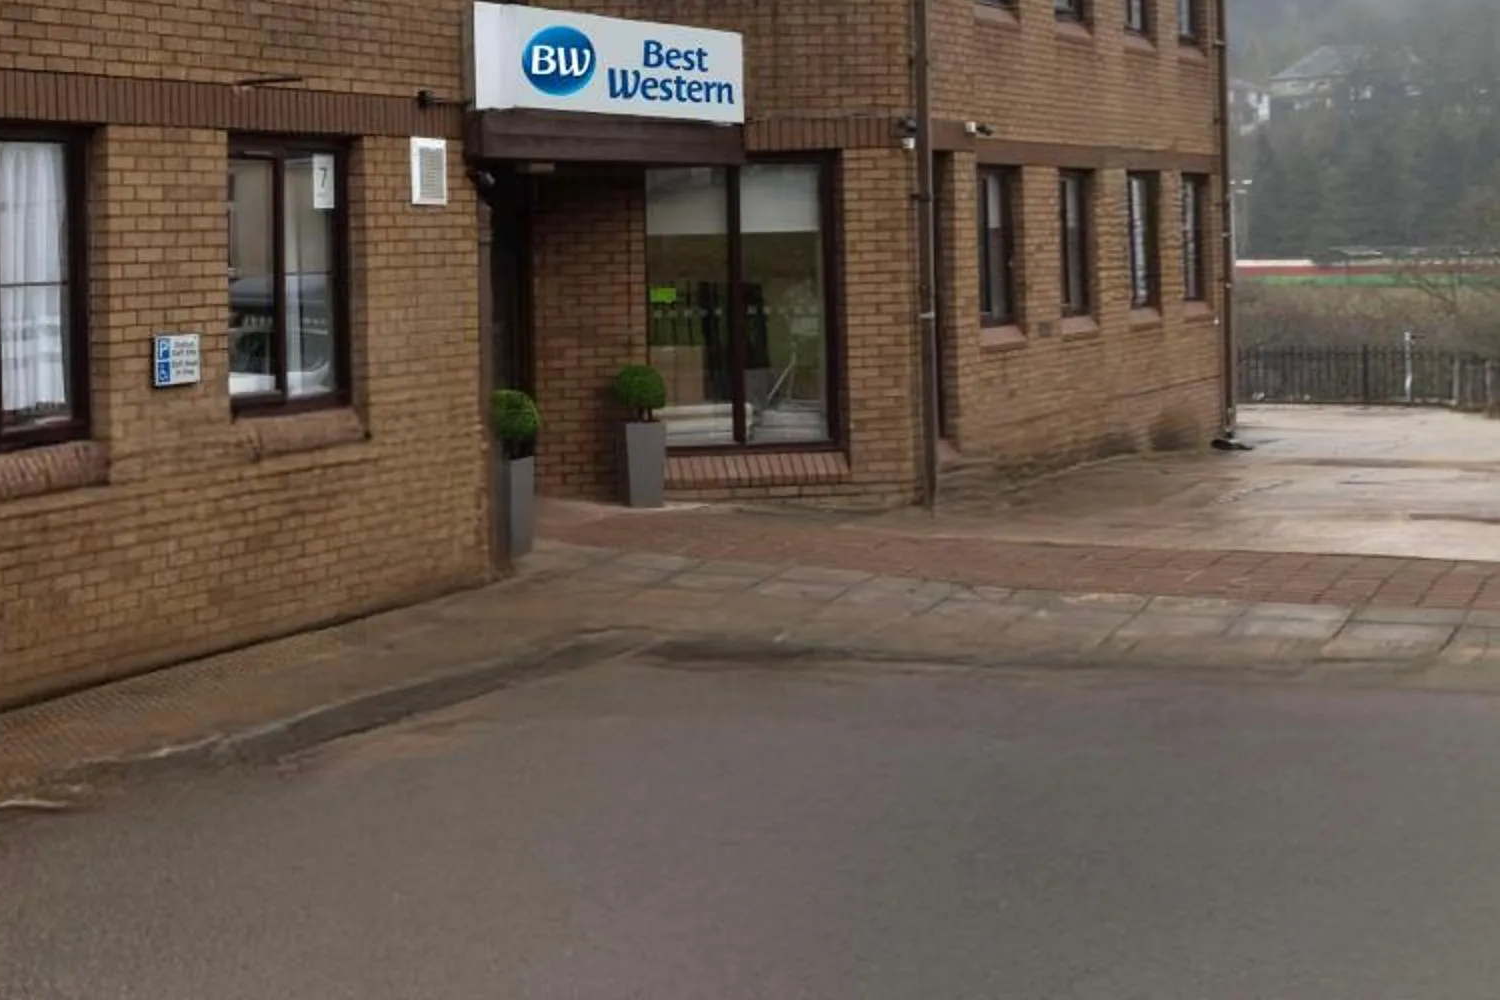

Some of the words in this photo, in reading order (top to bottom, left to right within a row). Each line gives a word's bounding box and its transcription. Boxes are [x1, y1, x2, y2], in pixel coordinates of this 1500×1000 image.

[531, 44, 591, 77] BW
[642, 39, 709, 72] Best
[607, 68, 735, 104] Western
